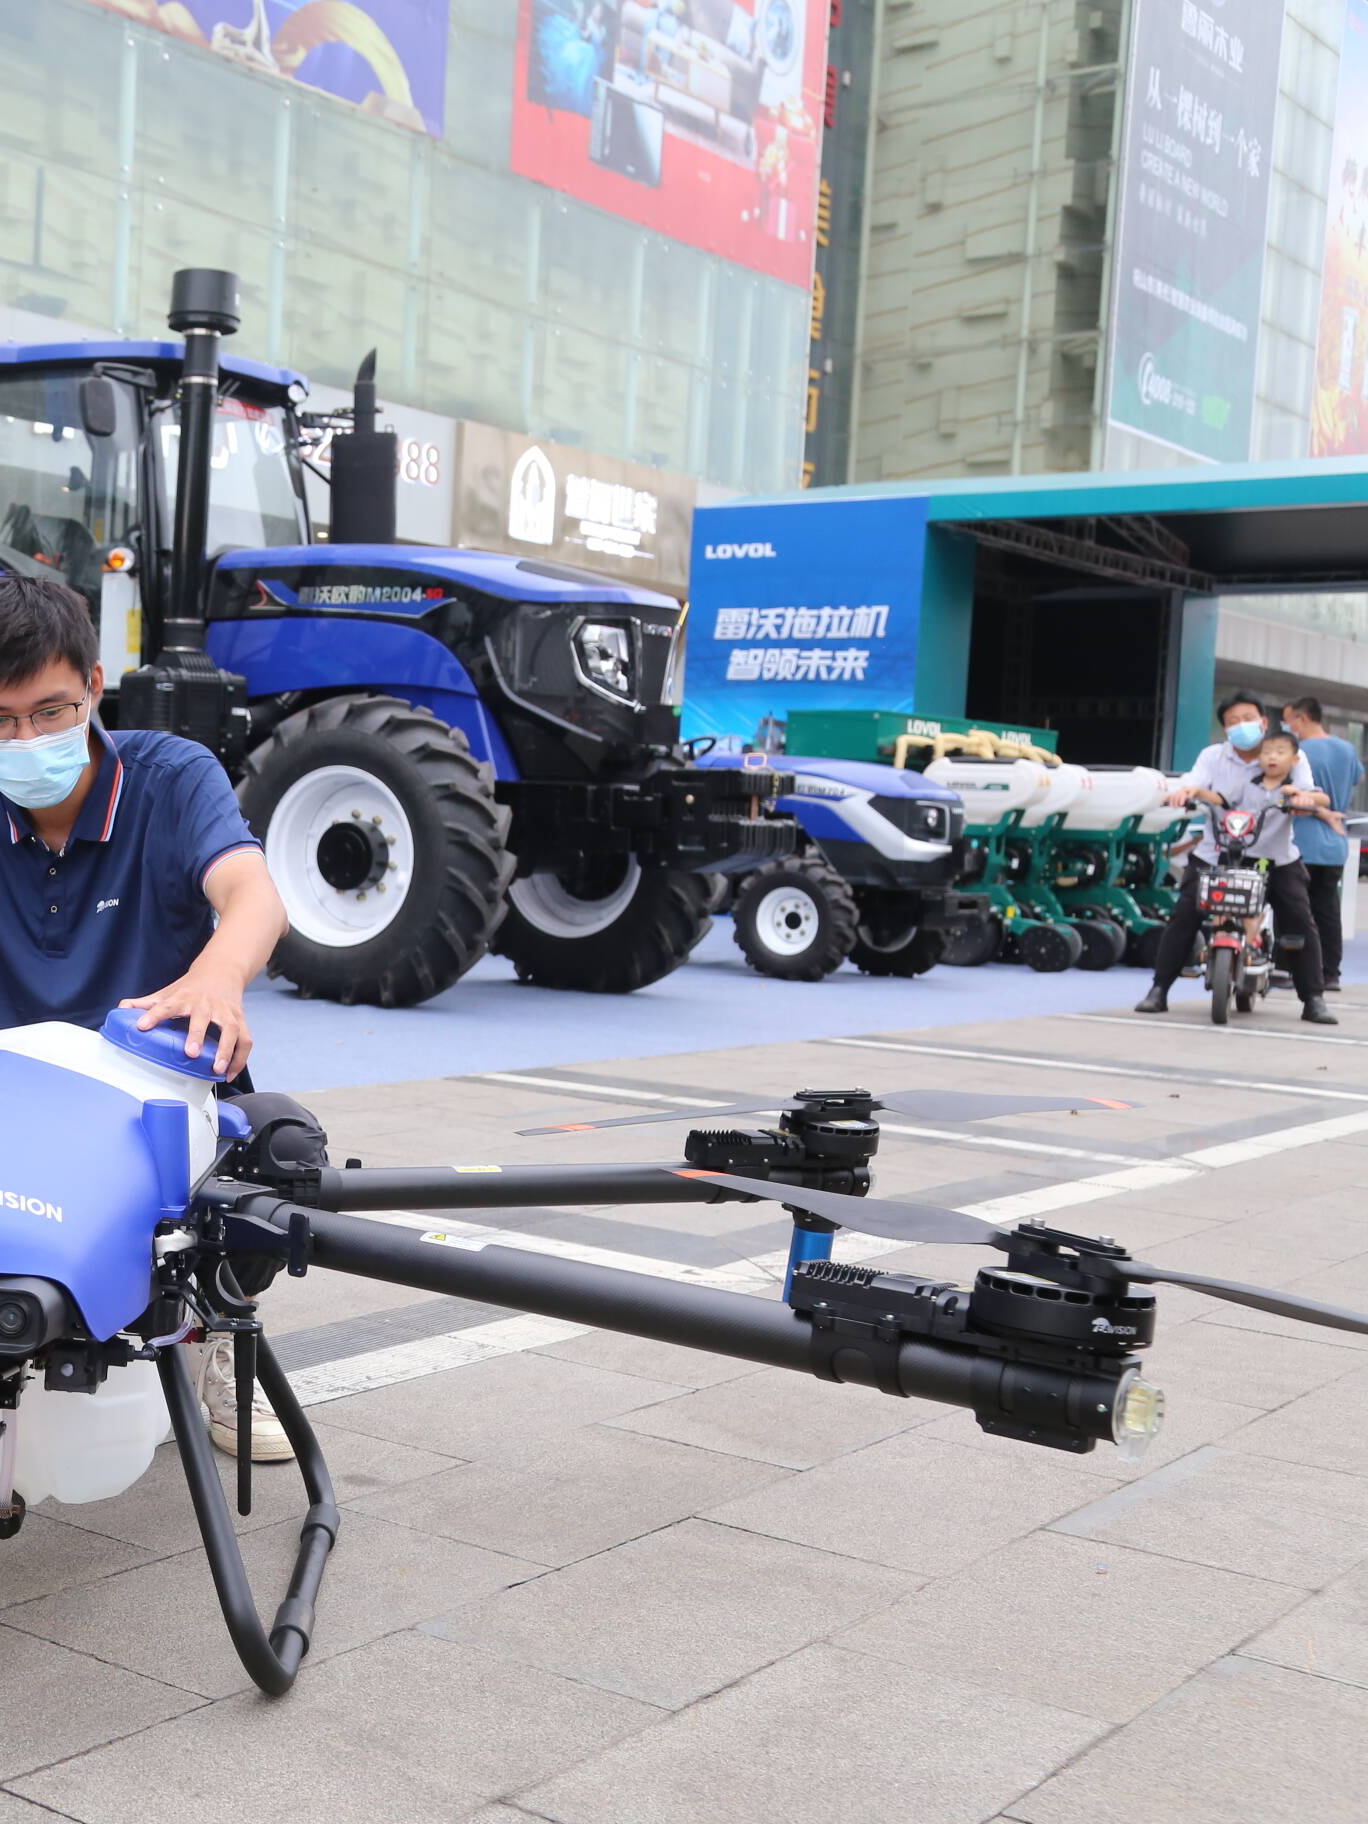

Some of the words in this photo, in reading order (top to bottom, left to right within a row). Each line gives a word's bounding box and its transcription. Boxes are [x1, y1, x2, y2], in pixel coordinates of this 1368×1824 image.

[705, 543, 776, 559] LOVOL
[713, 605, 890, 640] 雷沃拖拉机
[725, 648, 870, 681] 智领未来
[906, 718, 942, 738] LOVOL
